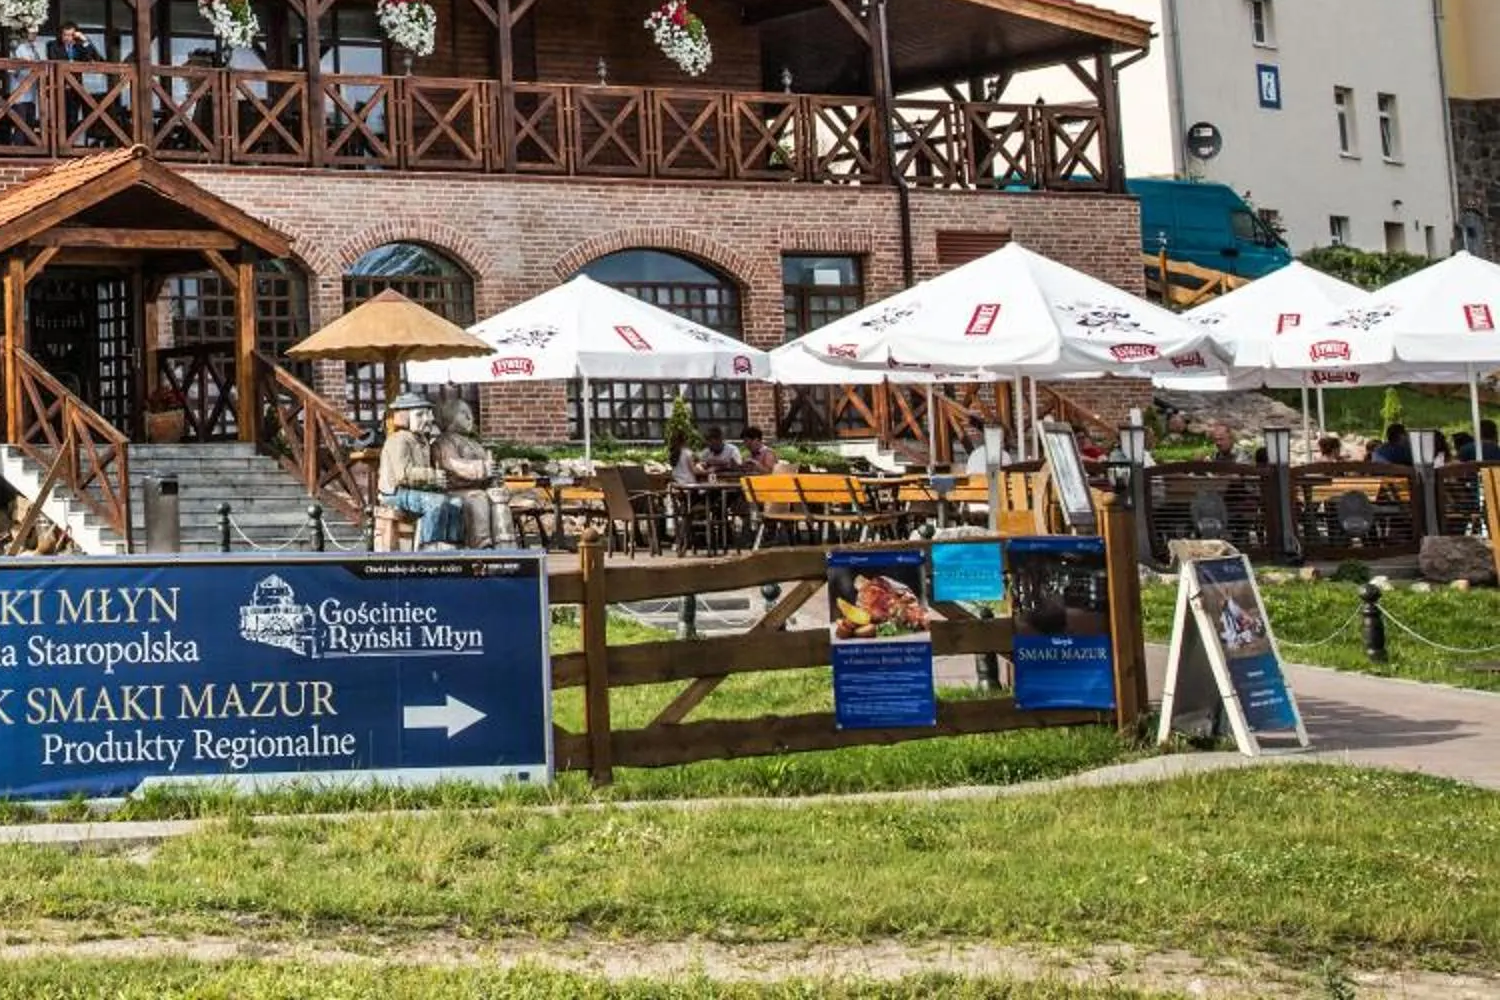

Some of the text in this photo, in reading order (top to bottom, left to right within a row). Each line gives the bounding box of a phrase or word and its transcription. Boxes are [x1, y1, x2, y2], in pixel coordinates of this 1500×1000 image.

[56, 587, 181, 624] MŁYN
[319, 597, 437, 625] Gościniec
[27, 631, 200, 675] Staropolska
[329, 625, 484, 653] Ryński Młyn
[26, 685, 165, 725] SMAKI
[177, 681, 339, 720] MAZUR
[41, 724, 356, 771] Produkty Regionalne
